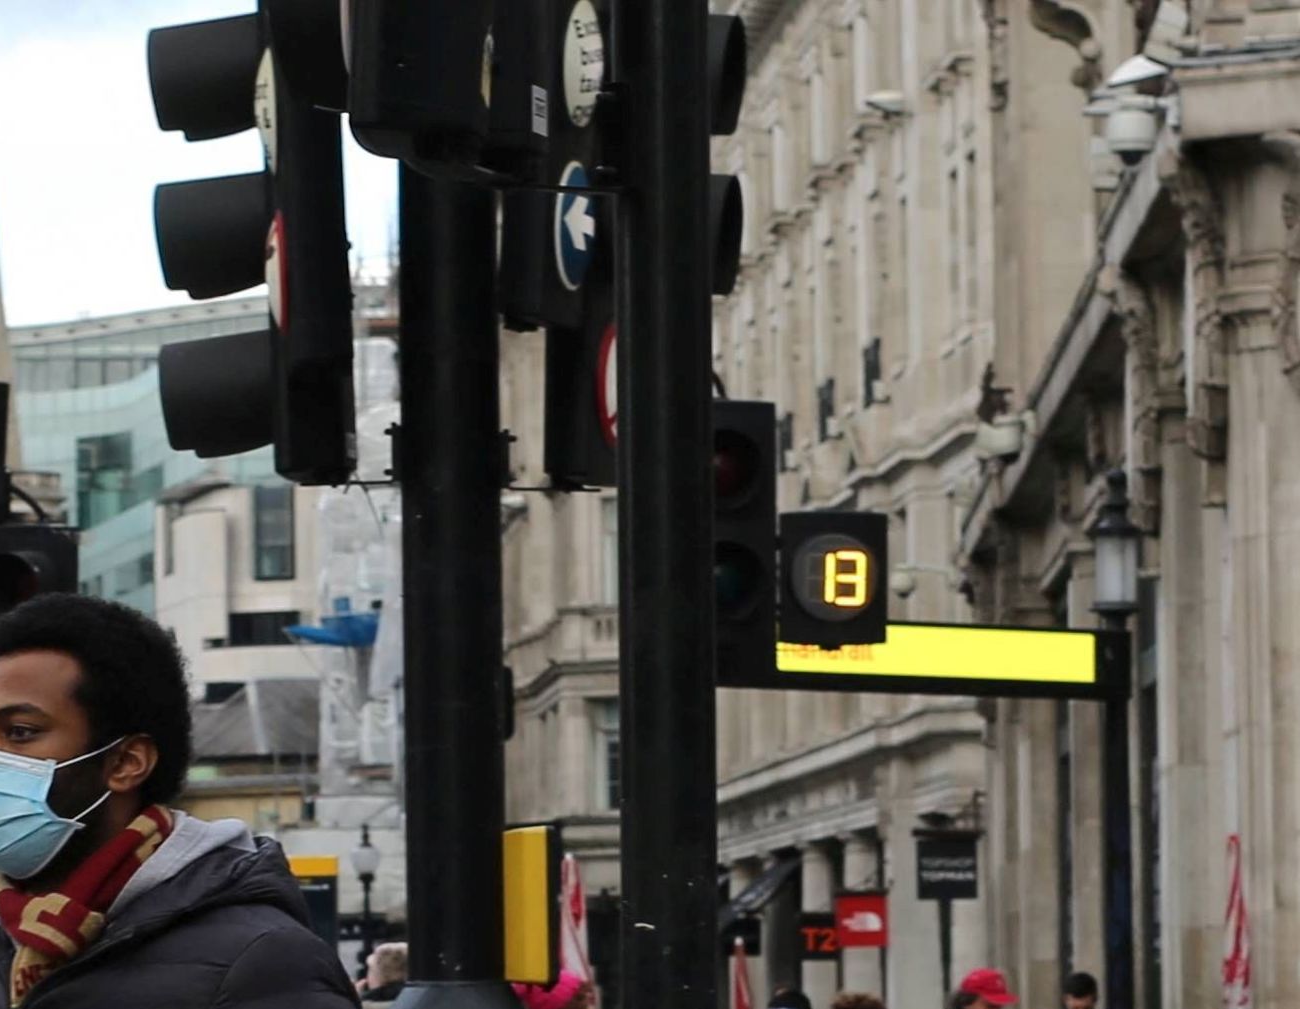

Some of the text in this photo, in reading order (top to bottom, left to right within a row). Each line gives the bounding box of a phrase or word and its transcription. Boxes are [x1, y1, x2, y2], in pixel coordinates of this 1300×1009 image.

[824, 551, 867, 607] 13
[921, 871, 976, 881] TOPMAN
[802, 927, 836, 953] T2
